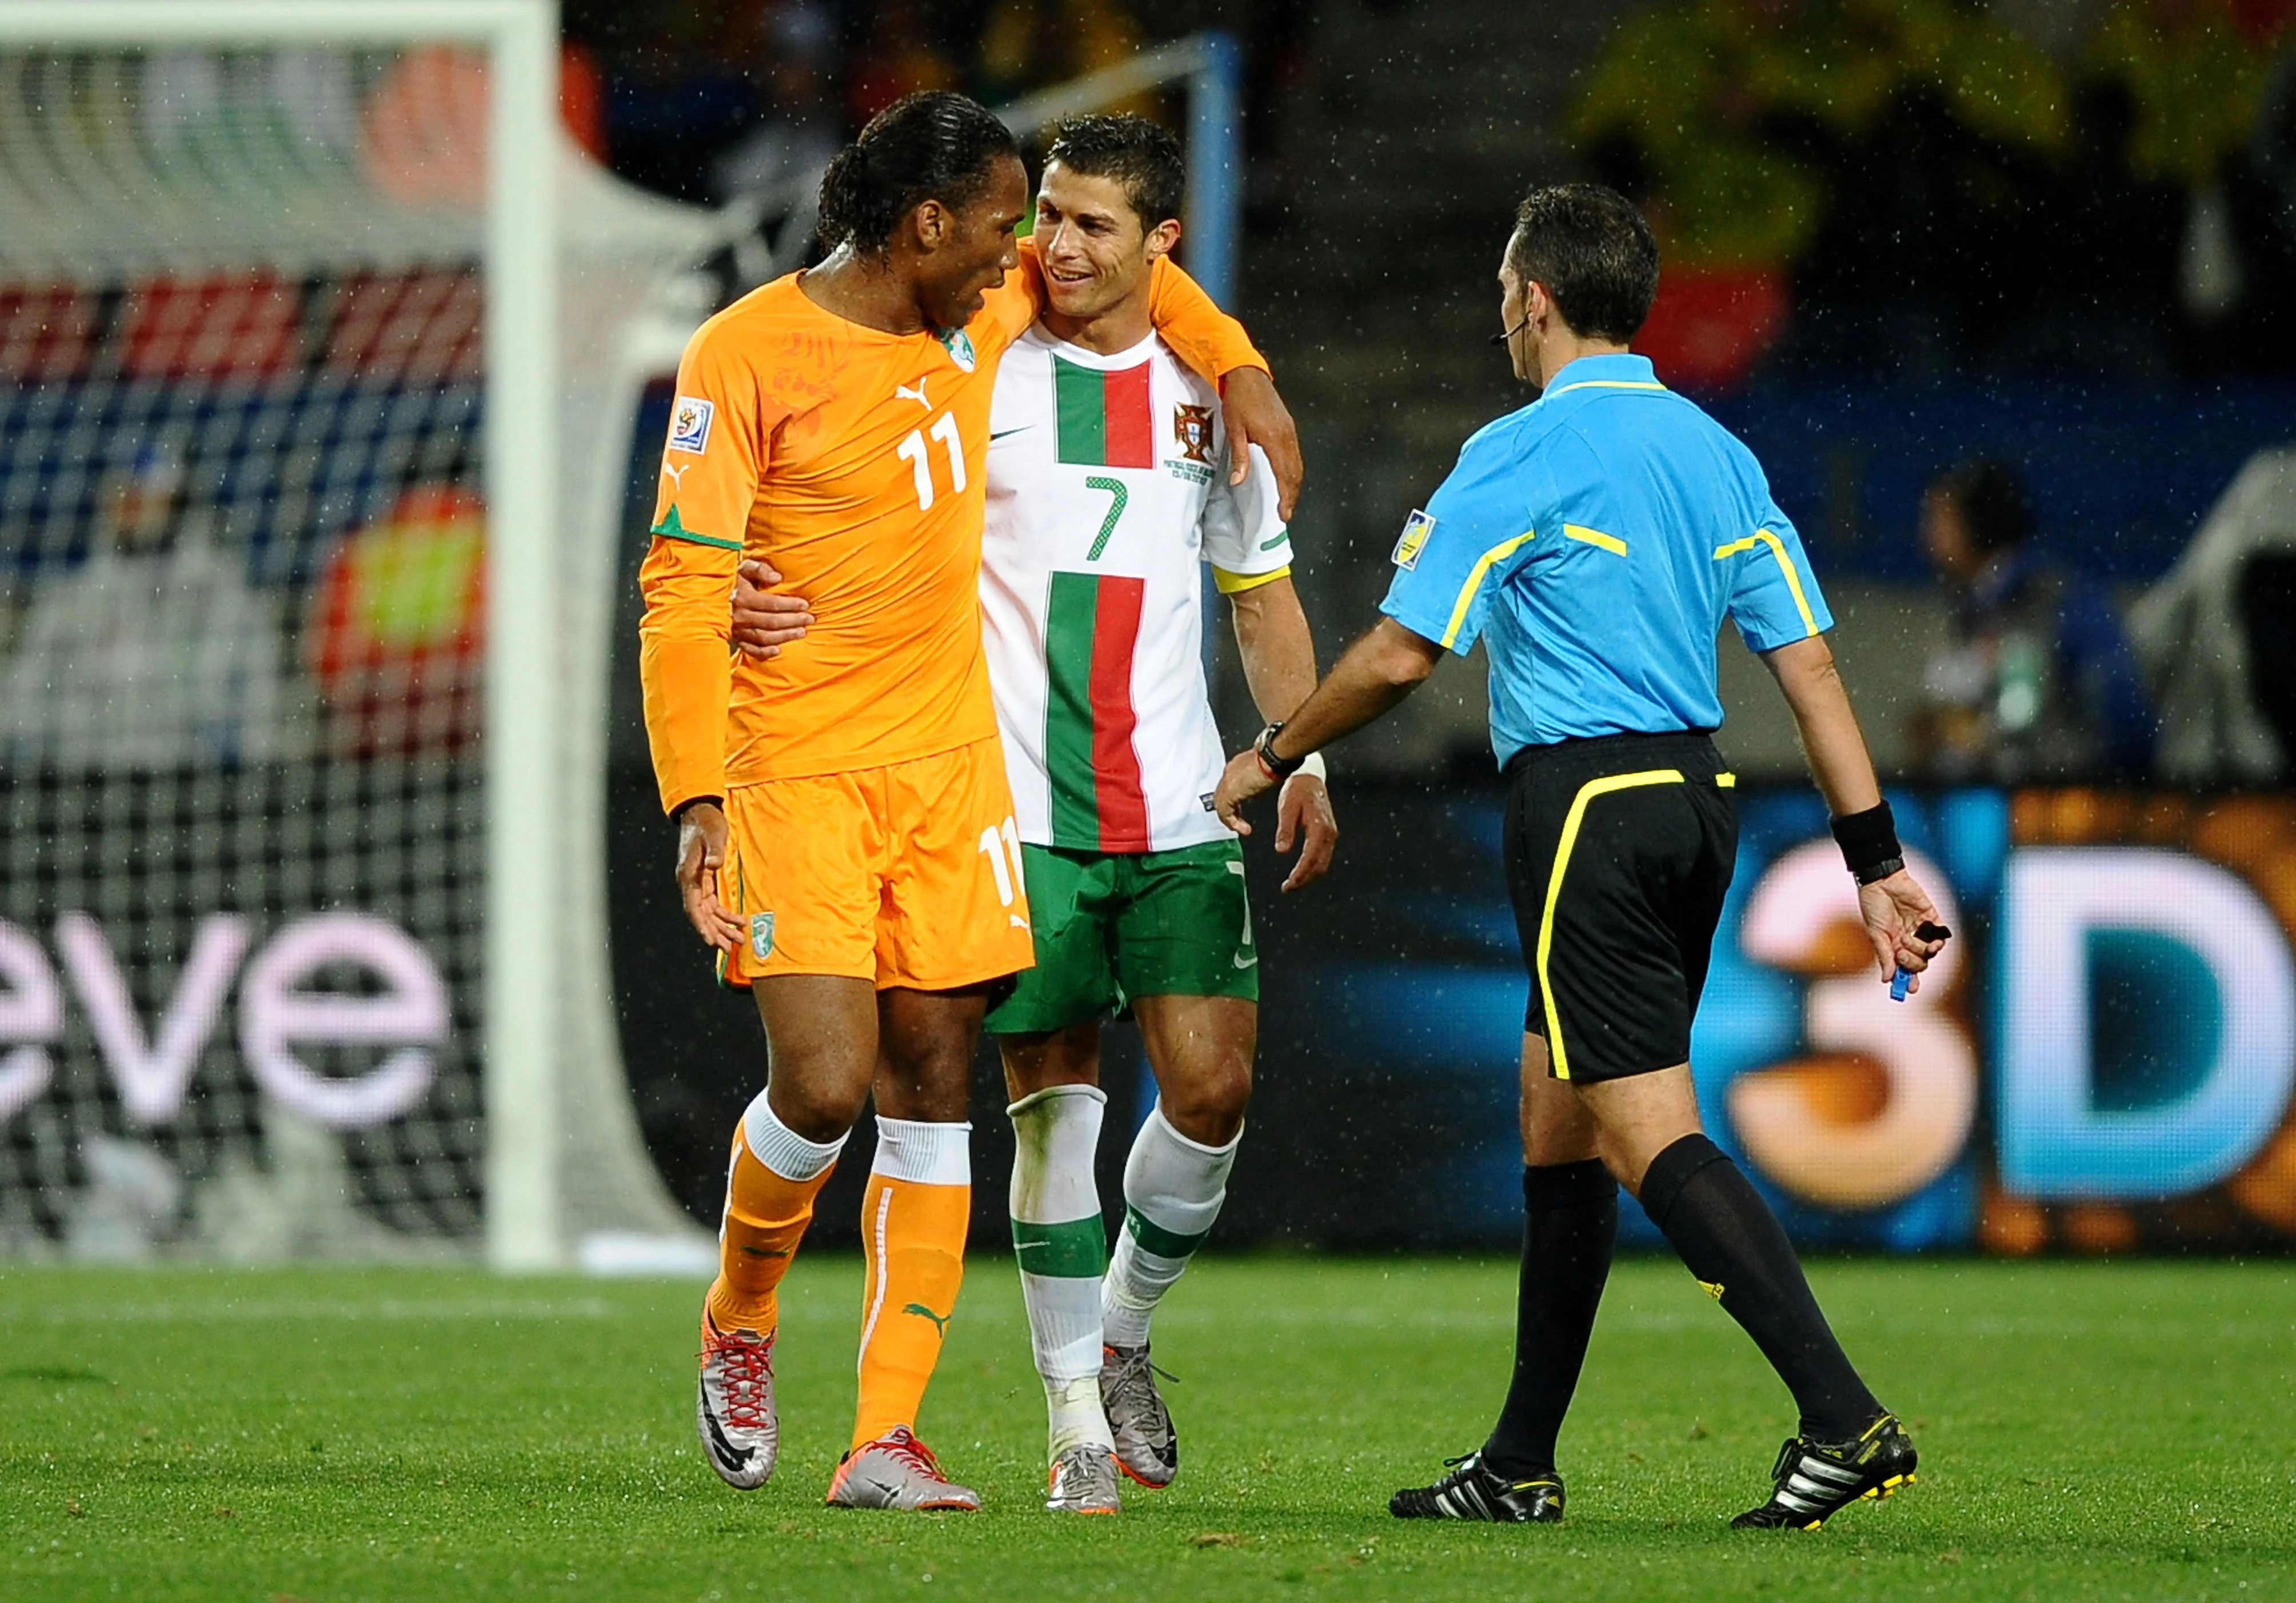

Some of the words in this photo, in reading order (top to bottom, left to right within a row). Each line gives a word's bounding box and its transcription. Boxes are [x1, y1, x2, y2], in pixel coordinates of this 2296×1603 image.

[897, 411, 967, 511] 11
[1085, 476, 1129, 561] 7
[978, 816, 1027, 907] 11
[1727, 837, 2296, 1205] 3D
